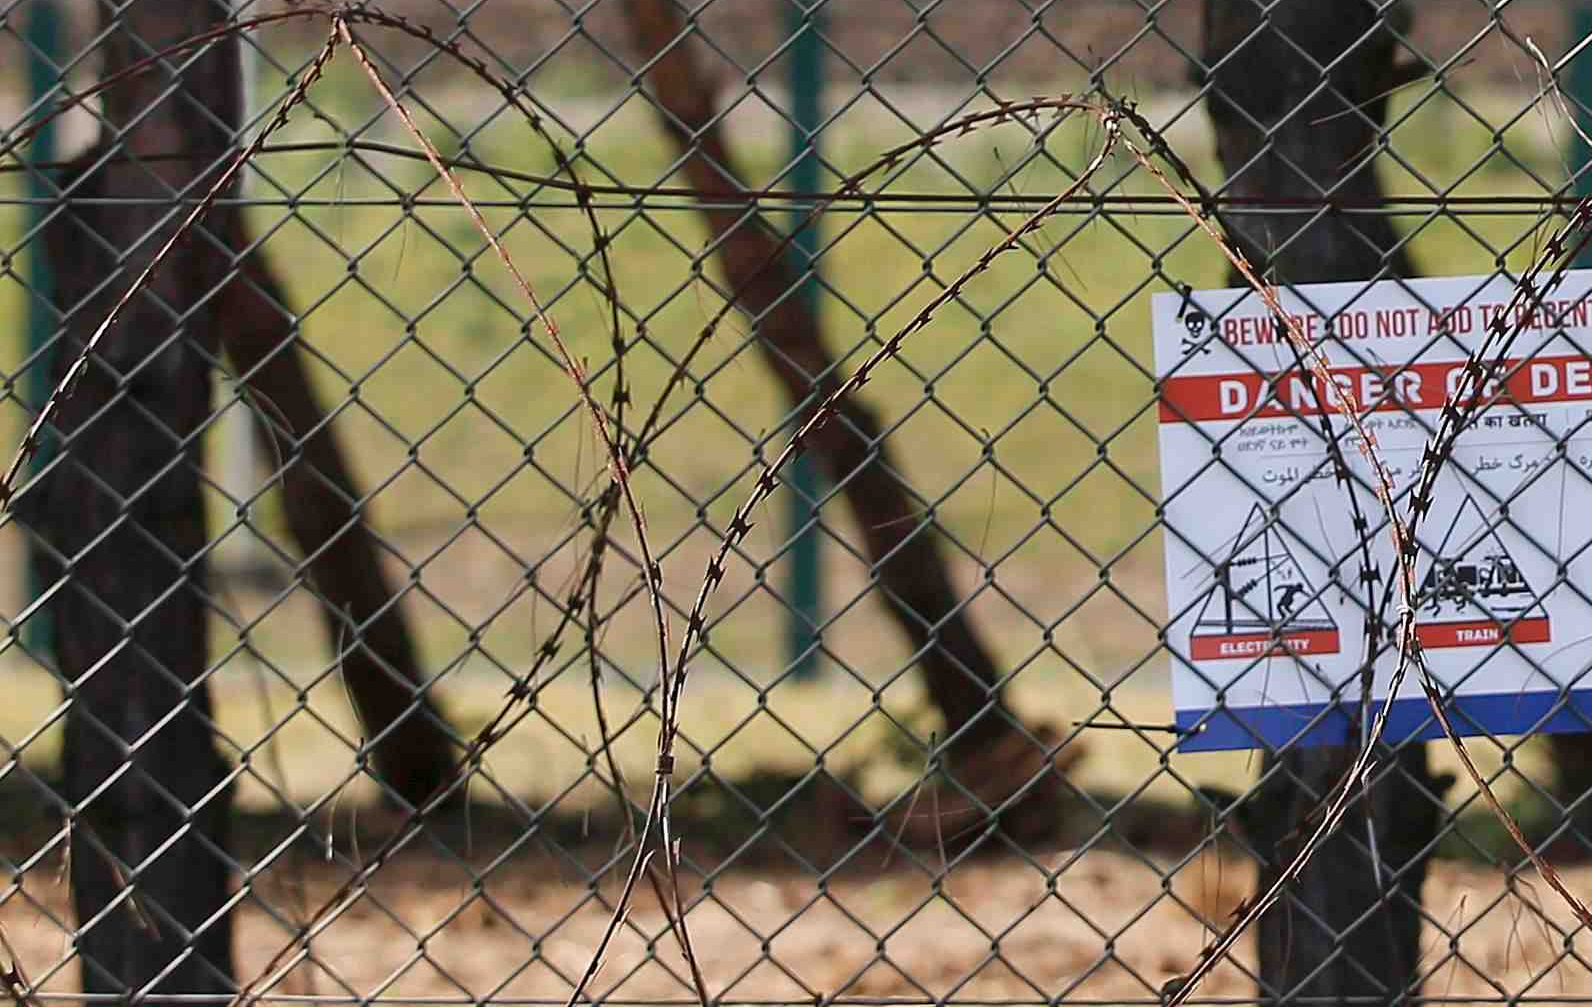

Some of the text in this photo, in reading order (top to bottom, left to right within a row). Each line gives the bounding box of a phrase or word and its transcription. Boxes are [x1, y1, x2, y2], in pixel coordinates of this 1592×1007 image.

[1224, 314, 1318, 344] BEWRE
[1339, 311, 1368, 339] DO
[1376, 308, 1419, 338] NOT
[1219, 370, 1424, 415] DANGER
[1219, 638, 1310, 655] ELECTITY
[1456, 628, 1499, 642] TRAIN
